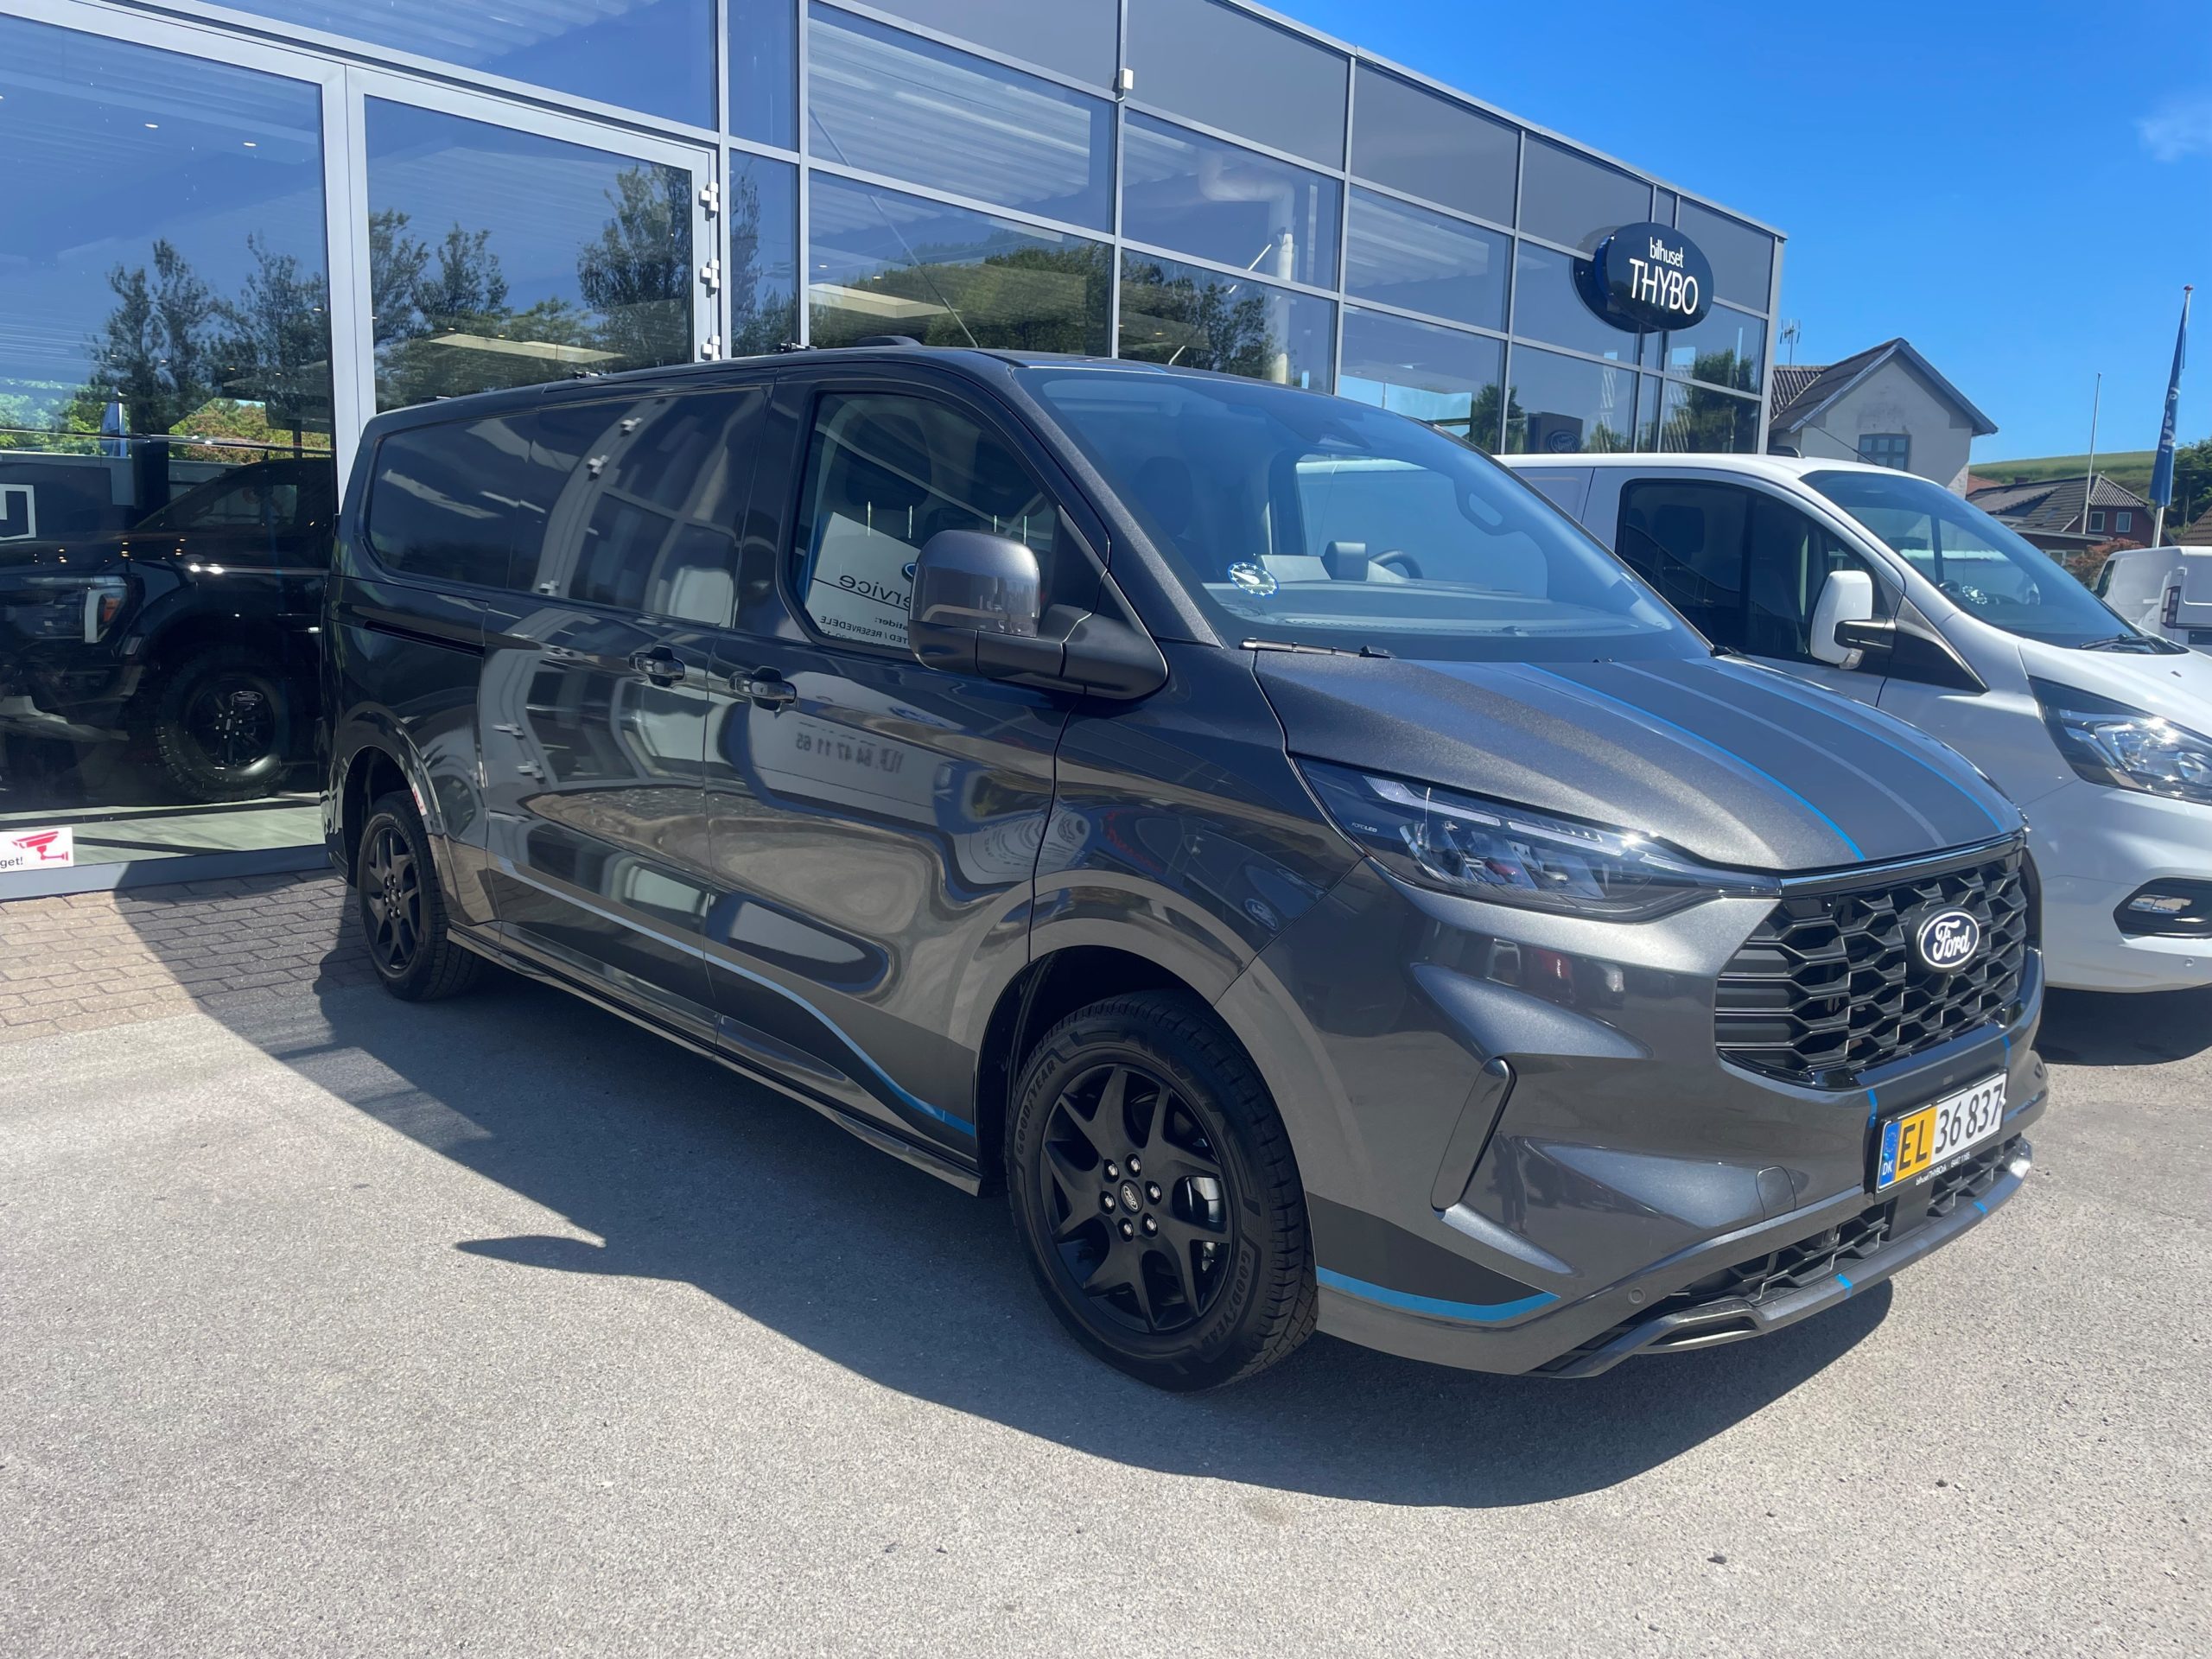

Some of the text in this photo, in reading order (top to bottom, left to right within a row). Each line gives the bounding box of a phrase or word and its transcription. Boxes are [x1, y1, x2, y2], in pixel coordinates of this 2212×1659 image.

[1649, 236, 1684, 269] bilhuset
[1629, 257, 1699, 315] THYBO
[0, 856, 23, 869] get!
[1932, 919, 1970, 961] Ford
[1016, 1059, 1056, 1155] GOODYEAR
[1898, 1082, 2004, 1172] EL 36 837
[1882, 1160, 1894, 1176] DK
